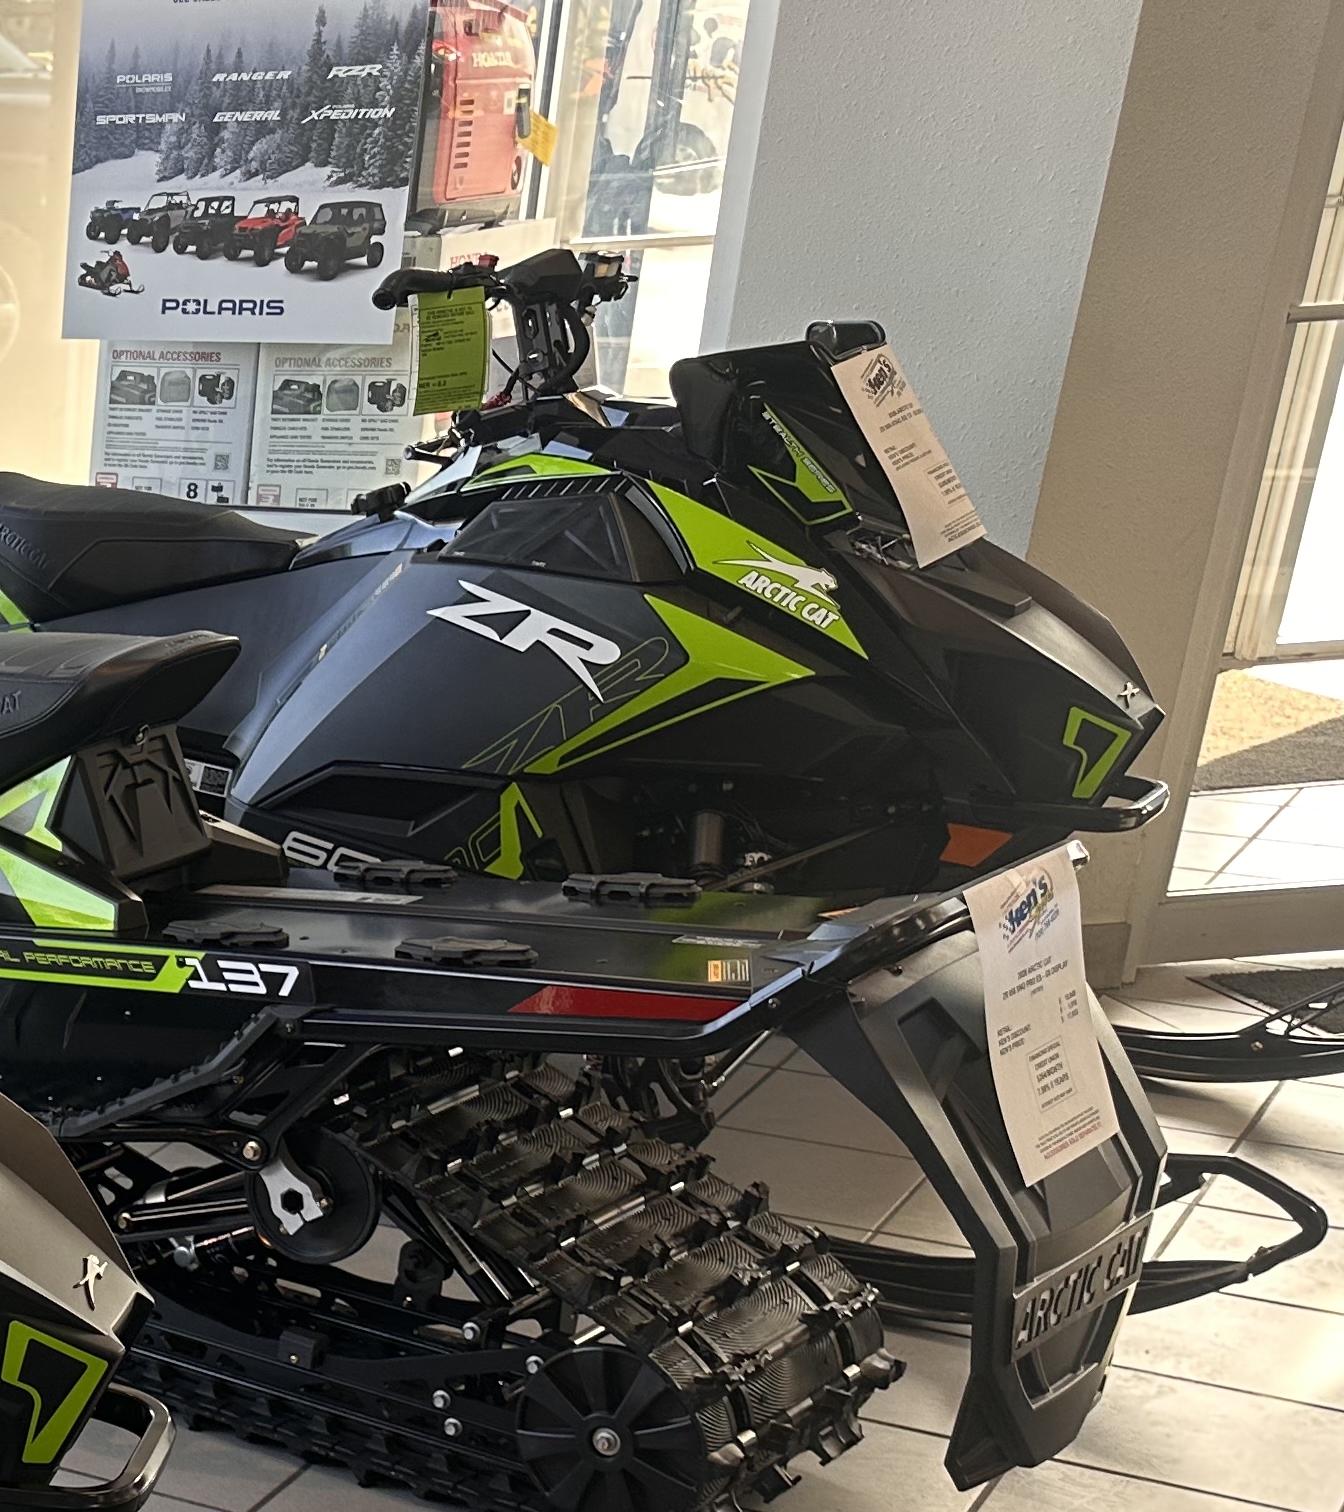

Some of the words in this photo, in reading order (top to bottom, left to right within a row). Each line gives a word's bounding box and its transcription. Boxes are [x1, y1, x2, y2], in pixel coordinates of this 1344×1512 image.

[116, 73, 173, 84] POLARIS
[212, 70, 292, 82] RANGER
[327, 64, 384, 79] RZR
[96, 112, 186, 126] SPORTSMAN
[213, 109, 281, 123] GENERAL
[301, 104, 395, 124] XPEDITION
[160, 298, 285, 316] POLARIS
[112, 350, 156, 361] OPTIONAL
[158, 351, 221, 363] ACCESSORIES
[275, 357, 322, 368] OPTIONAL
[324, 357, 393, 368] ACCESSORIES
[186, 483, 198, 499] 8
[737, 570, 806, 612] ARCTIC
[801, 602, 840, 629] CAT
[426, 579, 621, 703] ZR
[23, 951, 156, 974] PERFORMANCE
[185, 957, 299, 997] 137
[1016, 1255, 1103, 1350] ARCTIC
[1104, 1226, 1149, 1292] CAT
